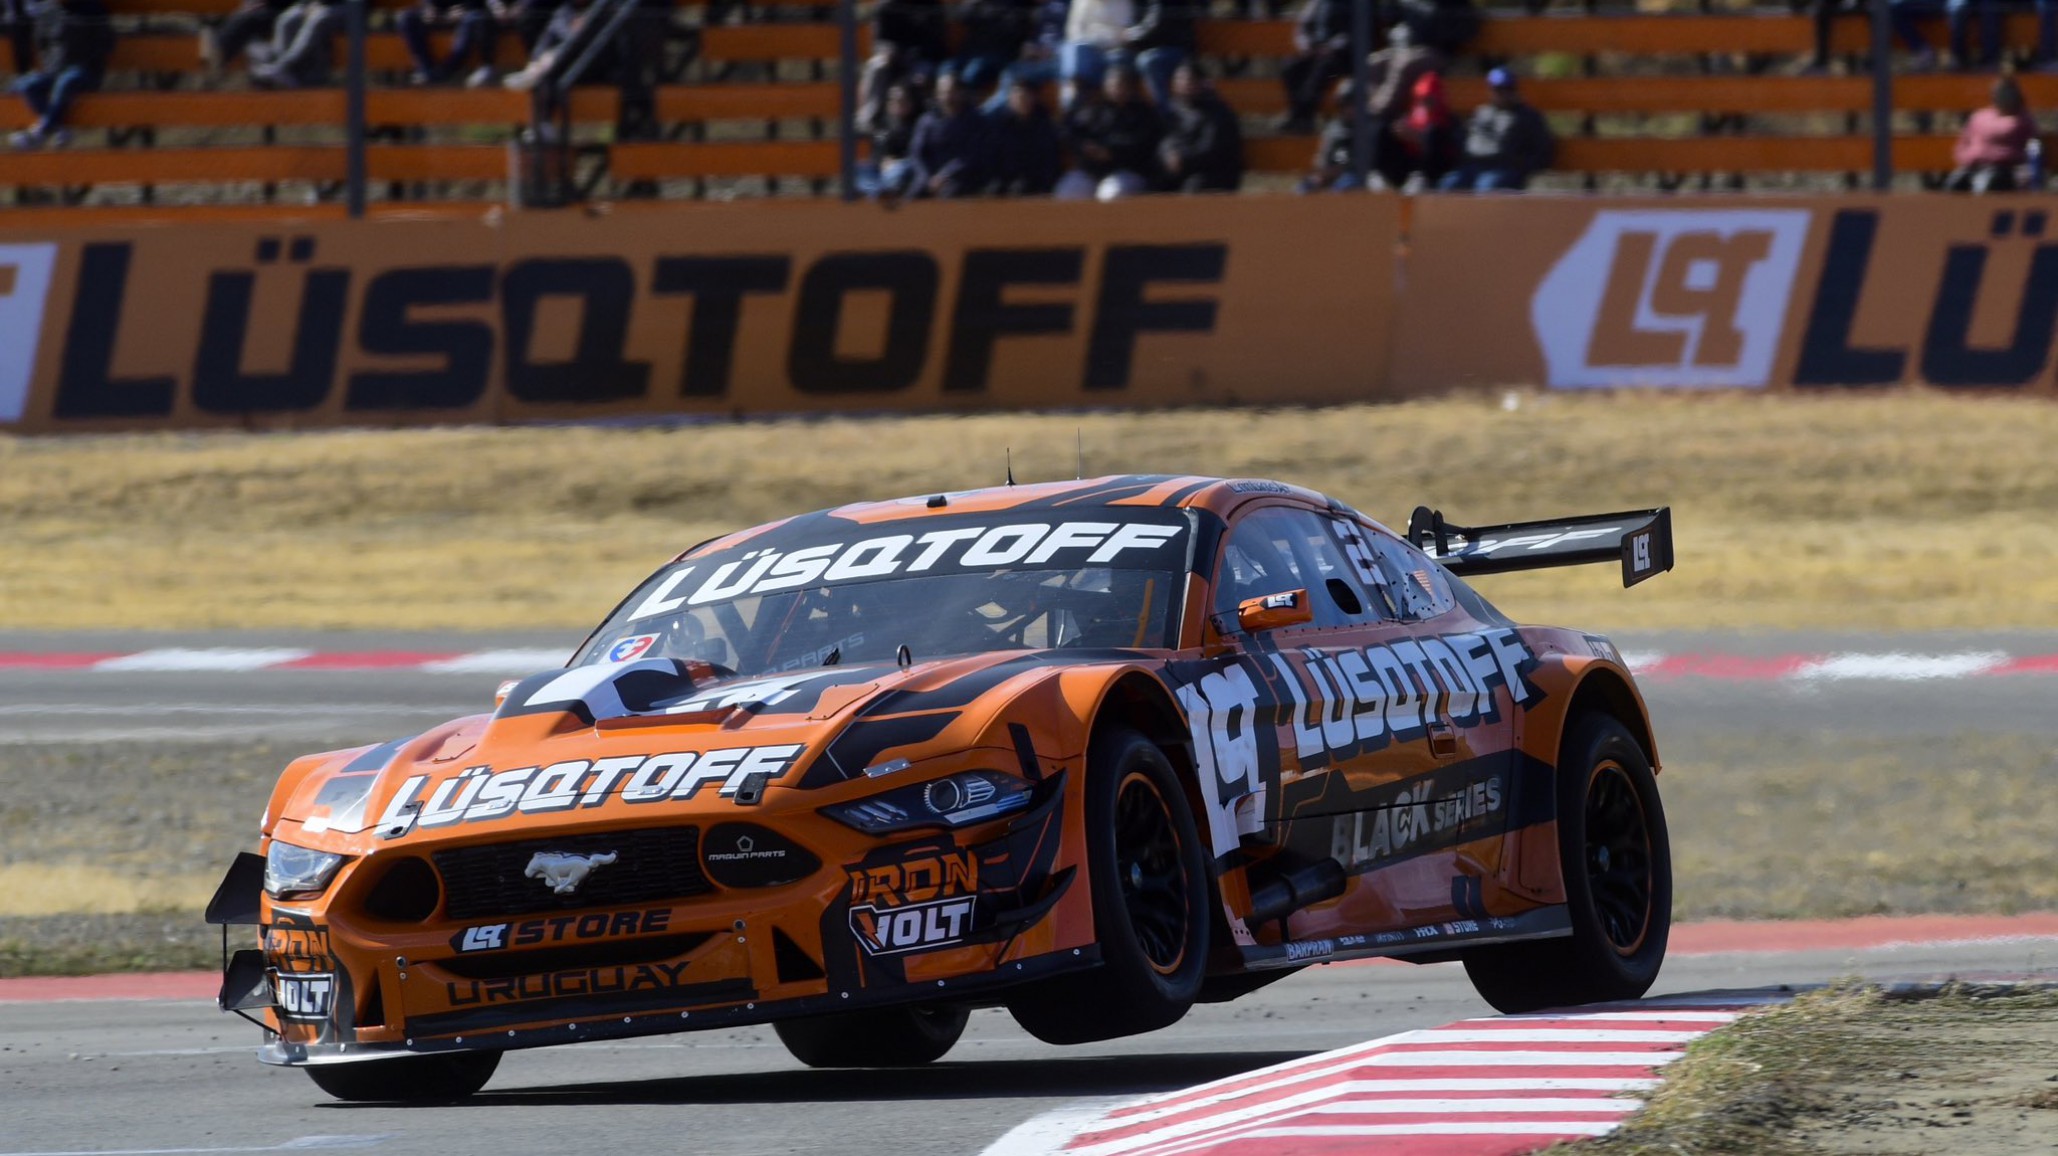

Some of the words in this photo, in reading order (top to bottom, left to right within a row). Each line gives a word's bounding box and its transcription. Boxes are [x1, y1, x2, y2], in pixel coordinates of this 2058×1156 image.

[51, 236, 1229, 419] LÜSQTOFF
[1793, 208, 2058, 388] LÜ
[627, 521, 1184, 623] LÜSQTOFF
[1271, 628, 1532, 759] LÜSQTOFF
[372, 743, 807, 839] LÜSQTOFF
[1331, 778, 1434, 867] BLACK
[1434, 776, 1502, 832] SERIES
[750, 850, 786, 858] PARTS
[514, 908, 673, 945] STORE
[860, 903, 970, 949] VOLT
[447, 961, 692, 1006] URUGUAY
